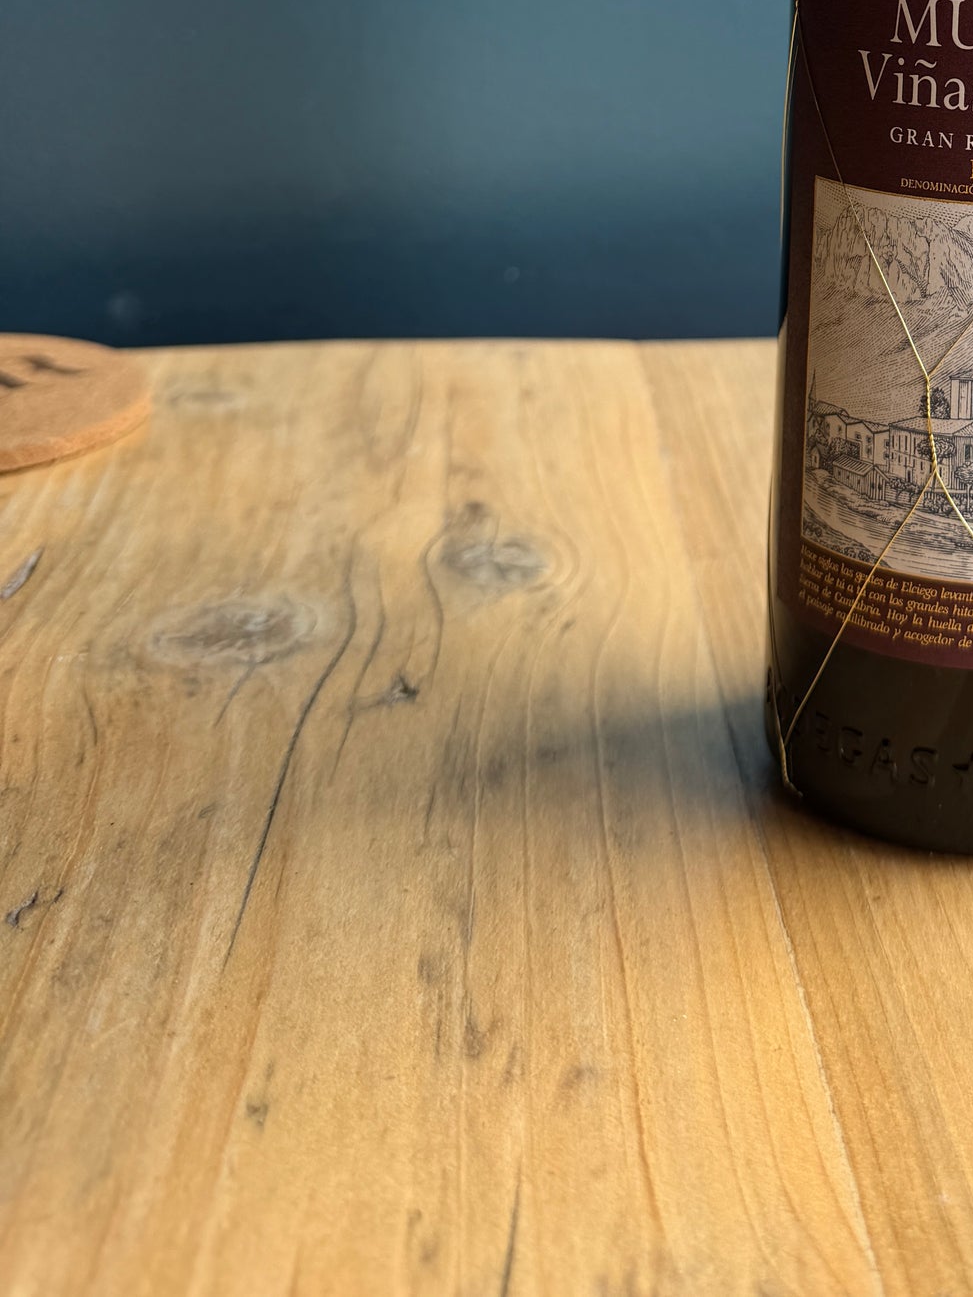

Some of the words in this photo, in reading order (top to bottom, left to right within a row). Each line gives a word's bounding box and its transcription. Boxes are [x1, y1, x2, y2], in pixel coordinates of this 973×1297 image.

[889, 126, 955, 150] GRAN
[824, 573, 834, 585] de
[847, 585, 854, 593] a
[868, 591, 886, 603] con
[889, 593, 904, 606] los
[906, 600, 949, 614] grandes
[841, 562, 853, 577] los
[886, 577, 898, 590] de
[901, 581, 938, 600] Elciego
[822, 586, 832, 598] de
[887, 608, 908, 624] Hoy
[912, 613, 923, 625] la
[928, 616, 962, 631] huella
[892, 627, 902, 640] y
[904, 630, 955, 646] acogedor
[958, 635, 972, 648] de
